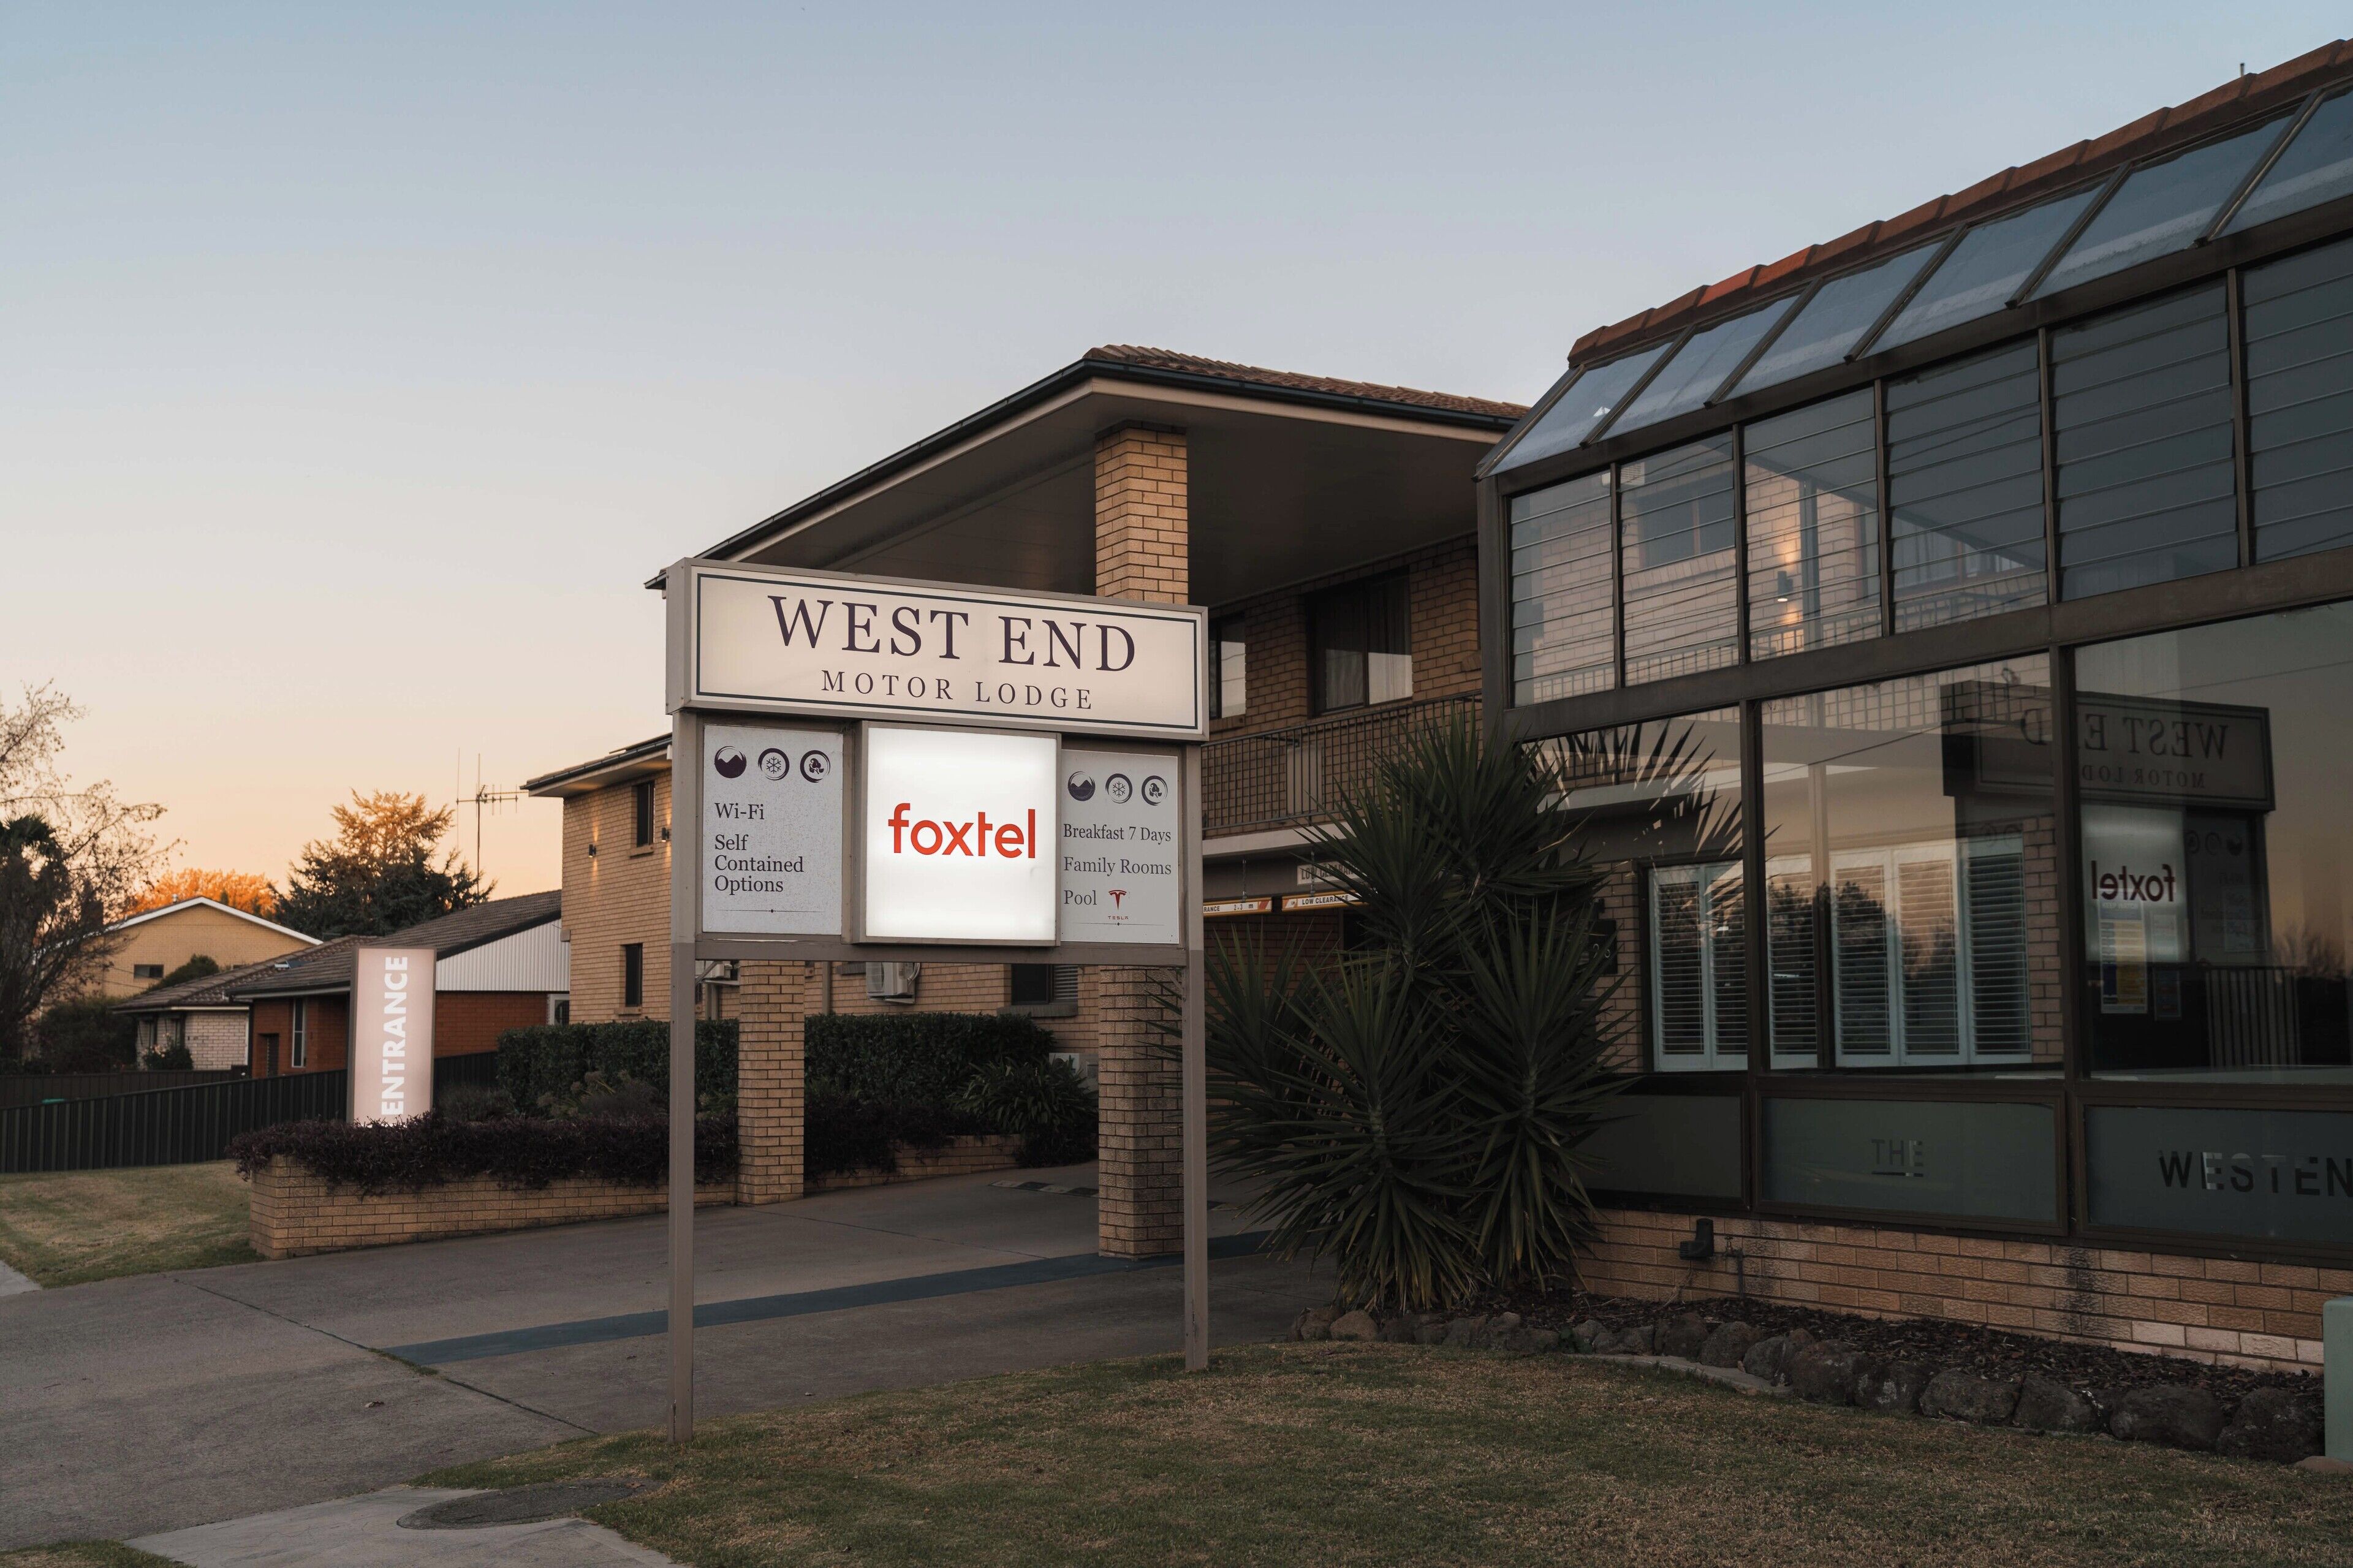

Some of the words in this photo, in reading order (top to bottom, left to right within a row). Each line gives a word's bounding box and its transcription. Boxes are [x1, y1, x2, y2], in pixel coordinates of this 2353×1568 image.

[768, 595, 968, 659] WEST
[998, 616, 1135, 672] END
[821, 670, 953, 700] MOTOR
[976, 681, 1091, 710] LODGE
[714, 802, 765, 820] Wi-Fi
[888, 803, 1036, 859] foxtel
[1063, 824, 1124, 840] Breakfast
[1129, 827, 1137, 840] 7
[1140, 827, 1172, 845] Days
[714, 834, 749, 850] Self
[714, 855, 804, 873] Contained
[1064, 857, 1116, 876] Family
[1120, 859, 1172, 874] Rooms
[714, 875, 784, 895] Options
[1064, 890, 1097, 906] Pool
[381, 956, 407, 1115] ENTRANCE
[1871, 1139, 1923, 1167] THE
